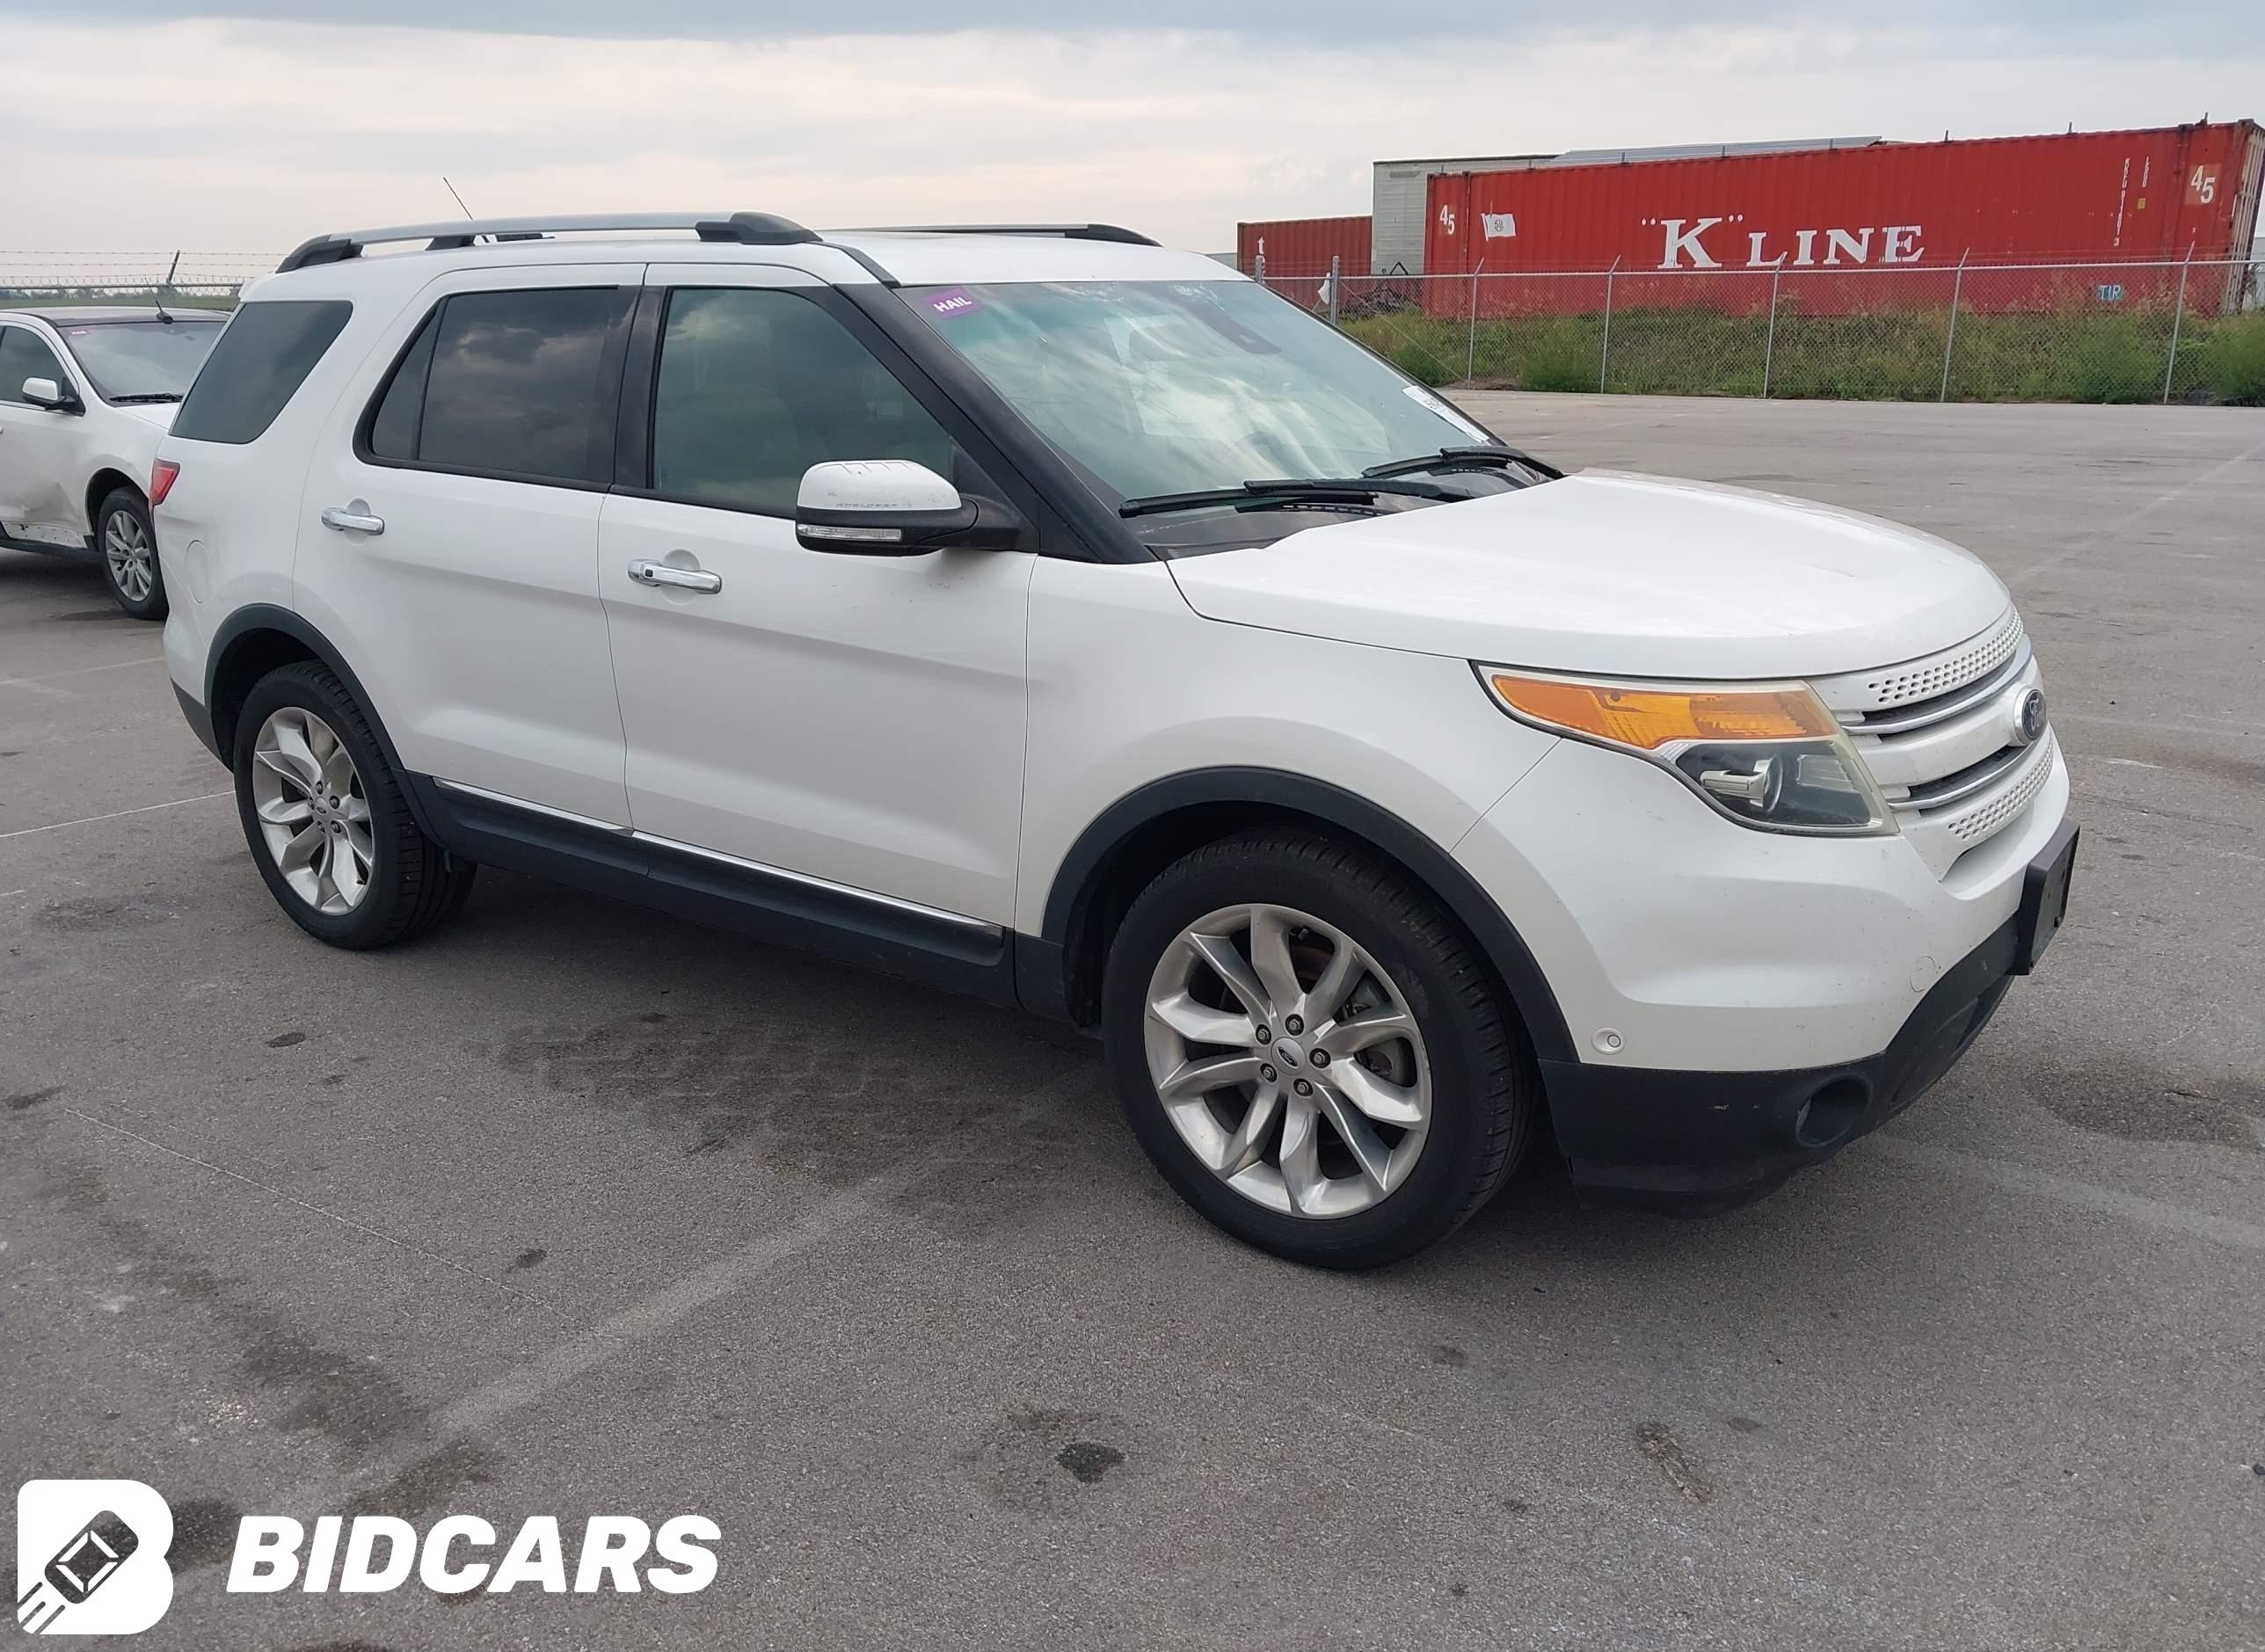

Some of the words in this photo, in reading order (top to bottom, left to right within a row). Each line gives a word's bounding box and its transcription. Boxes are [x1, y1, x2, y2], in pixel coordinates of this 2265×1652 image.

[2190, 164, 2216, 204] 45
[1439, 204, 1455, 235] 45
[1745, 225, 1926, 267] LINE
[932, 295, 973, 313] HAIL
[2100, 284, 2122, 301] TIR
